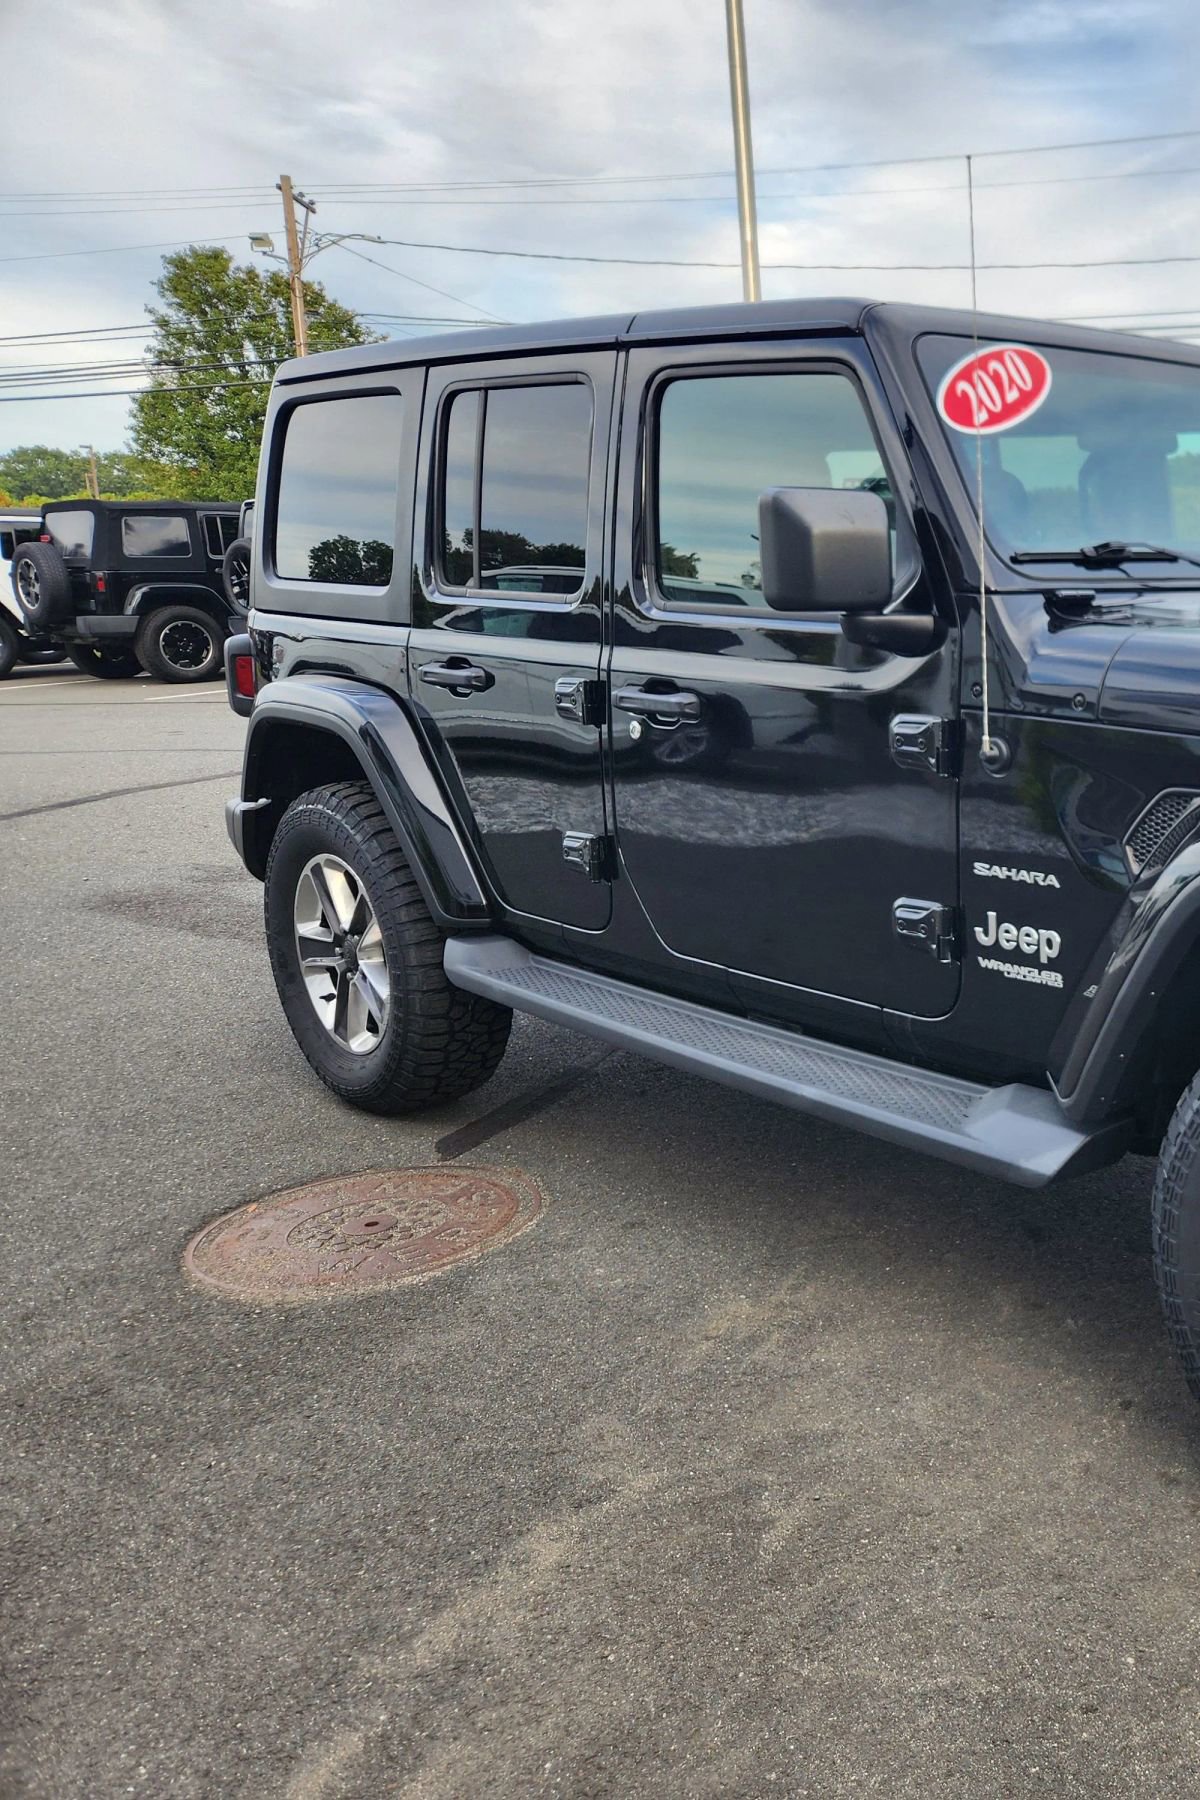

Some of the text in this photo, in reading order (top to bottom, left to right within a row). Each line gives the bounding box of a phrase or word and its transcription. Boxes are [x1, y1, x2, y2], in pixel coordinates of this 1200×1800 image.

[955, 350, 1032, 427] 2020
[973, 862, 1060, 888] SAHARA
[974, 911, 1061, 964] Jeep
[977, 956, 1063, 982] WRANGLER
